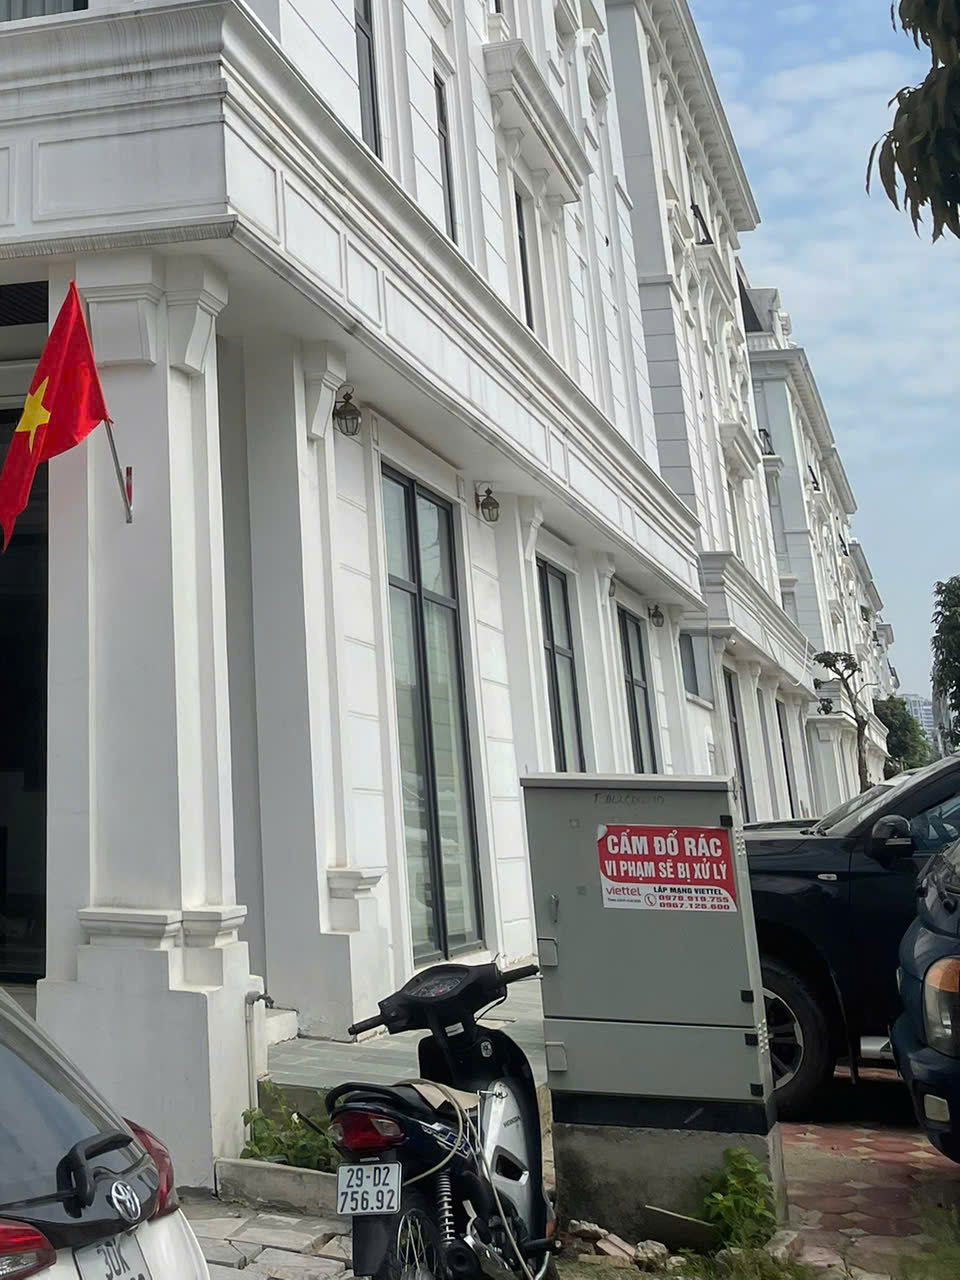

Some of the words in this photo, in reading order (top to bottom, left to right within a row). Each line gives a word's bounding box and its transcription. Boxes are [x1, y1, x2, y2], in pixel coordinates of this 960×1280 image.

[606, 829, 649, 855] CẤM
[653, 829, 679, 856] ĐỔ
[683, 833, 722, 857] RÁC
[604, 860, 617, 876] VI
[620, 861, 656, 880] PHẠM
[658, 859, 675, 878] SẼ
[677, 862, 691, 882] BỊ
[693, 858, 710, 879] XỬ
[713, 860, 727, 880] LÝ
[605, 887, 641, 896] viettel
[694, 887, 723, 895] VIETTEL
[346, 1166, 391, 1188] 29-D2
[340, 1189, 395, 1212] 756.92
